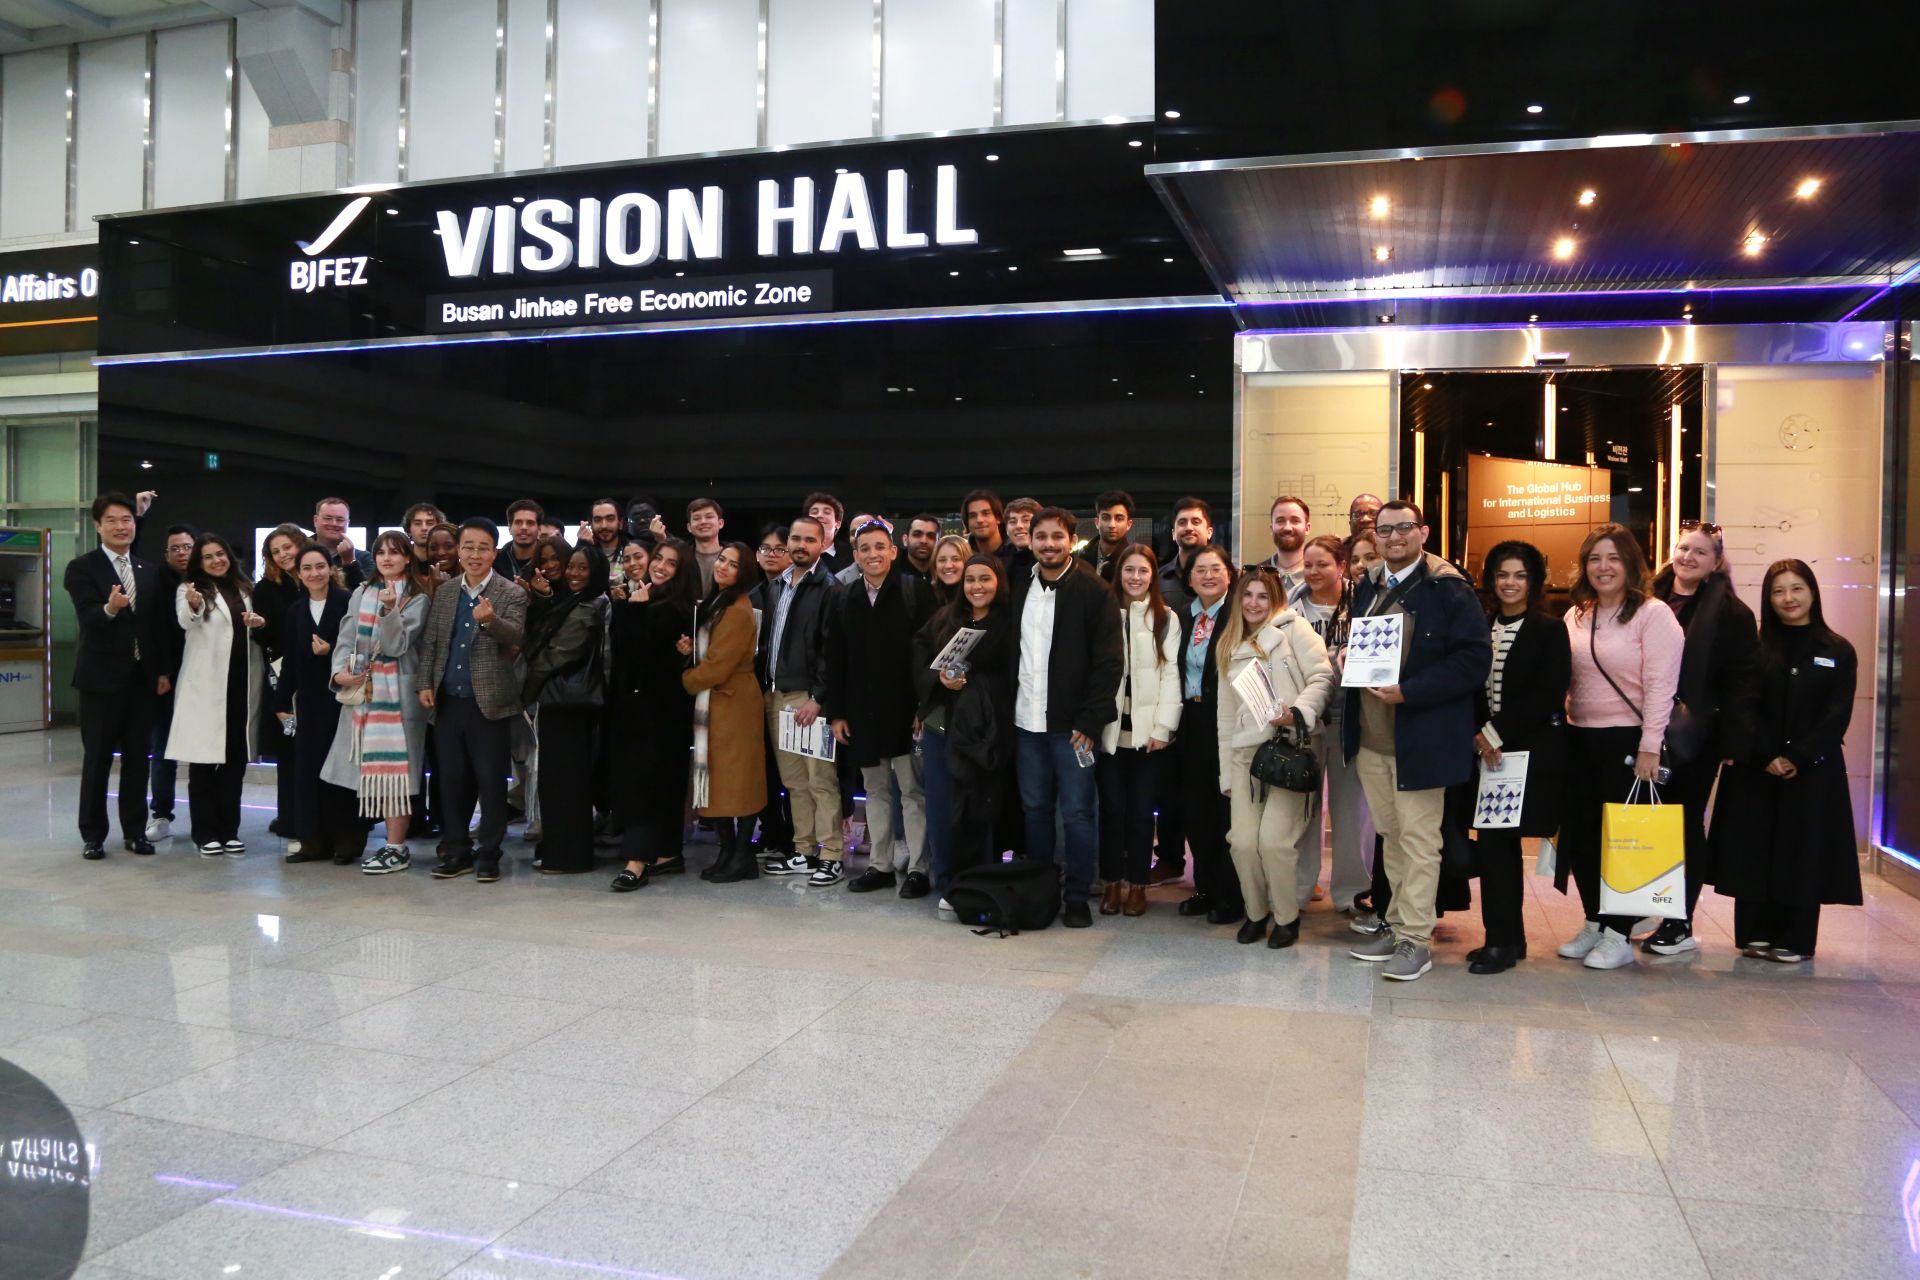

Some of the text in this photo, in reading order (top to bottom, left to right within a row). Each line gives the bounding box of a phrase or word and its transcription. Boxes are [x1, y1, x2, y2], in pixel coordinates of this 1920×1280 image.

[436, 164, 979, 278] VISION HALL
[2, 271, 78, 303] Affairs
[290, 256, 369, 294] BJFEZ
[442, 283, 812, 323] Busan Jinhae Free Economic Zone
[1483, 493, 1610, 508] for International Business
[1506, 481, 1582, 495] The Global Hub
[1507, 506, 1576, 519] and Logistics
